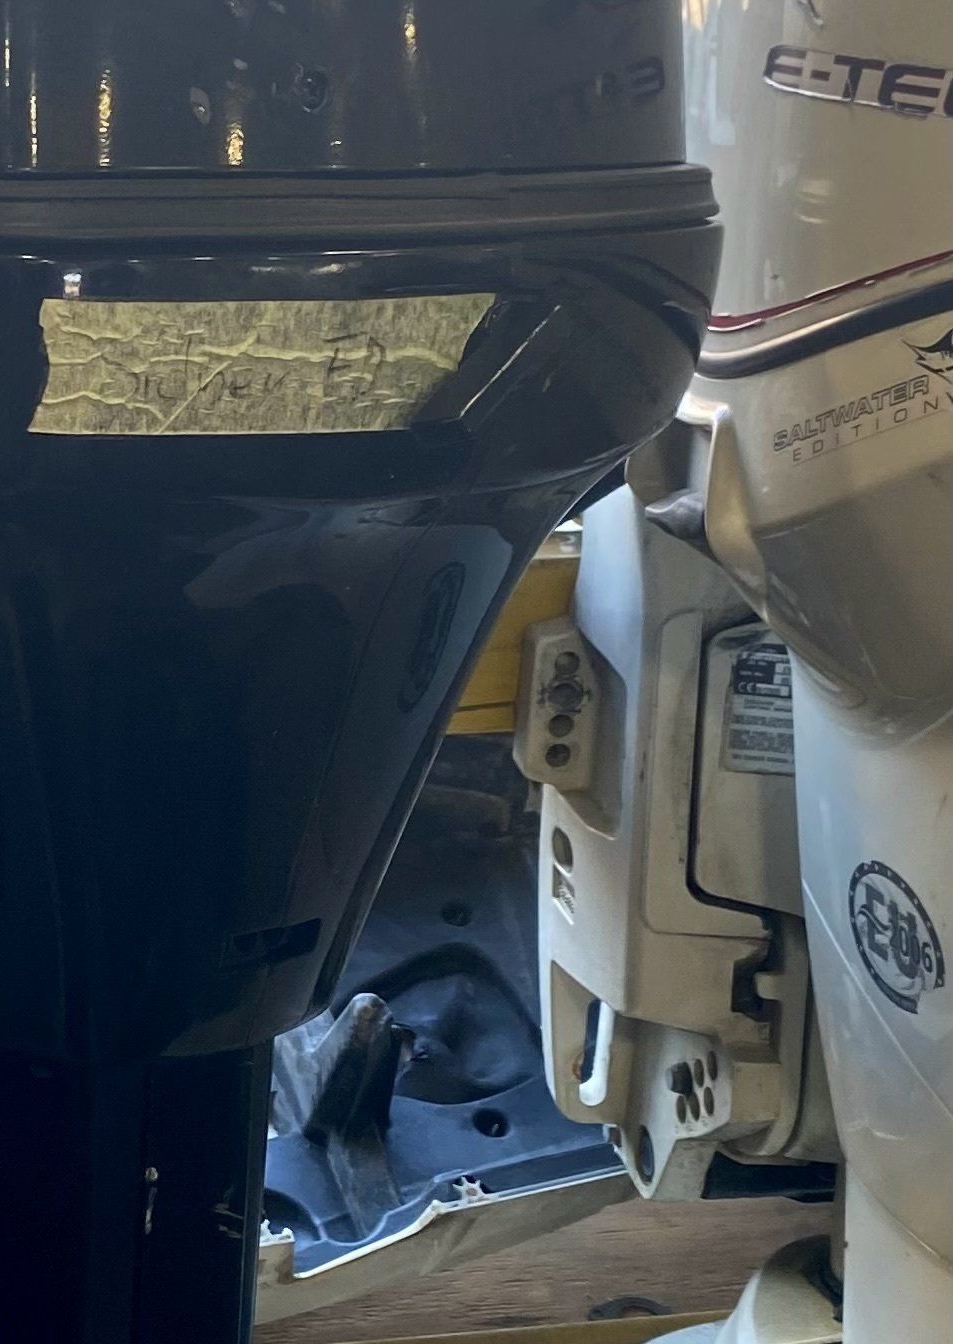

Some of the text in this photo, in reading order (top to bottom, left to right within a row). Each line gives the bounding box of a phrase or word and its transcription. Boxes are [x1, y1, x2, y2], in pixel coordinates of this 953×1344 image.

[763, 45, 953, 116] E-TE
[773, 374, 930, 452] SALTWATER
[792, 396, 939, 463] EDITION
